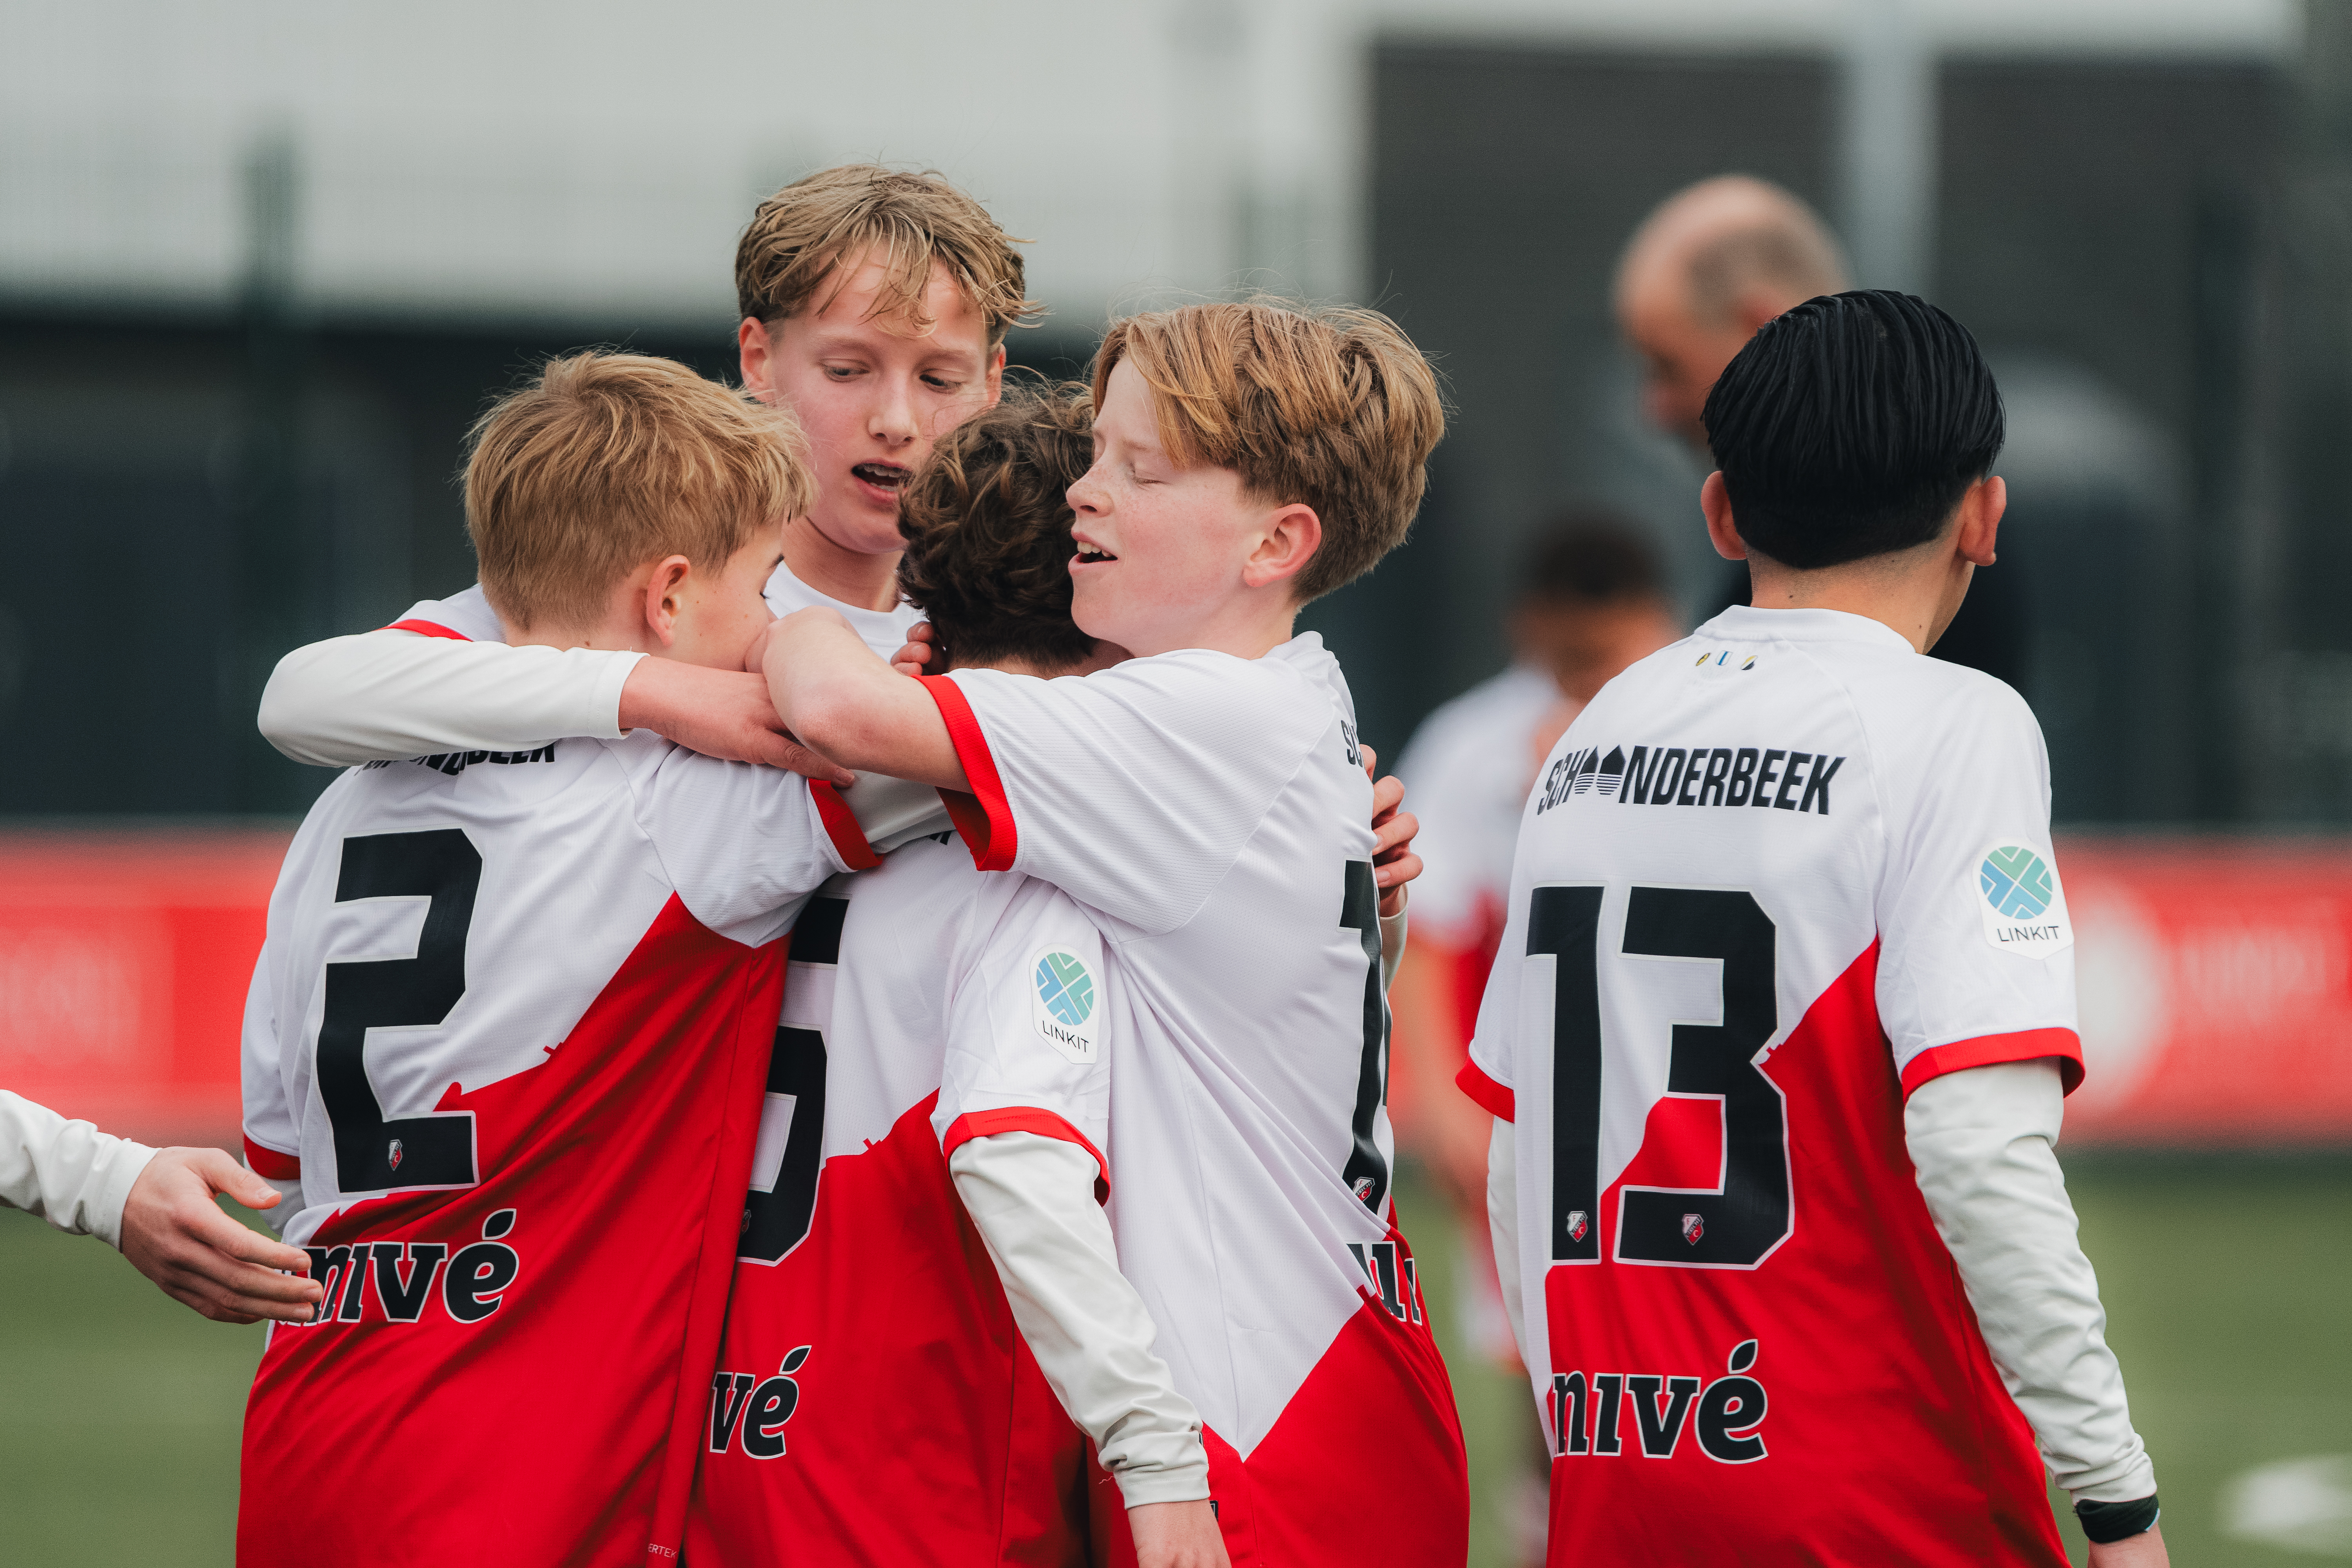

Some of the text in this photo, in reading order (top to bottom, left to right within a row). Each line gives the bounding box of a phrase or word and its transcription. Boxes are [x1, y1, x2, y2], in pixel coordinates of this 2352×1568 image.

[1996, 926, 2059, 942] LINKIT
[315, 825, 485, 1196] 2
[1042, 1020, 1089, 1053] LINKIT
[1525, 881, 1795, 1270] 13
[274, 1209, 519, 1327] nivé
